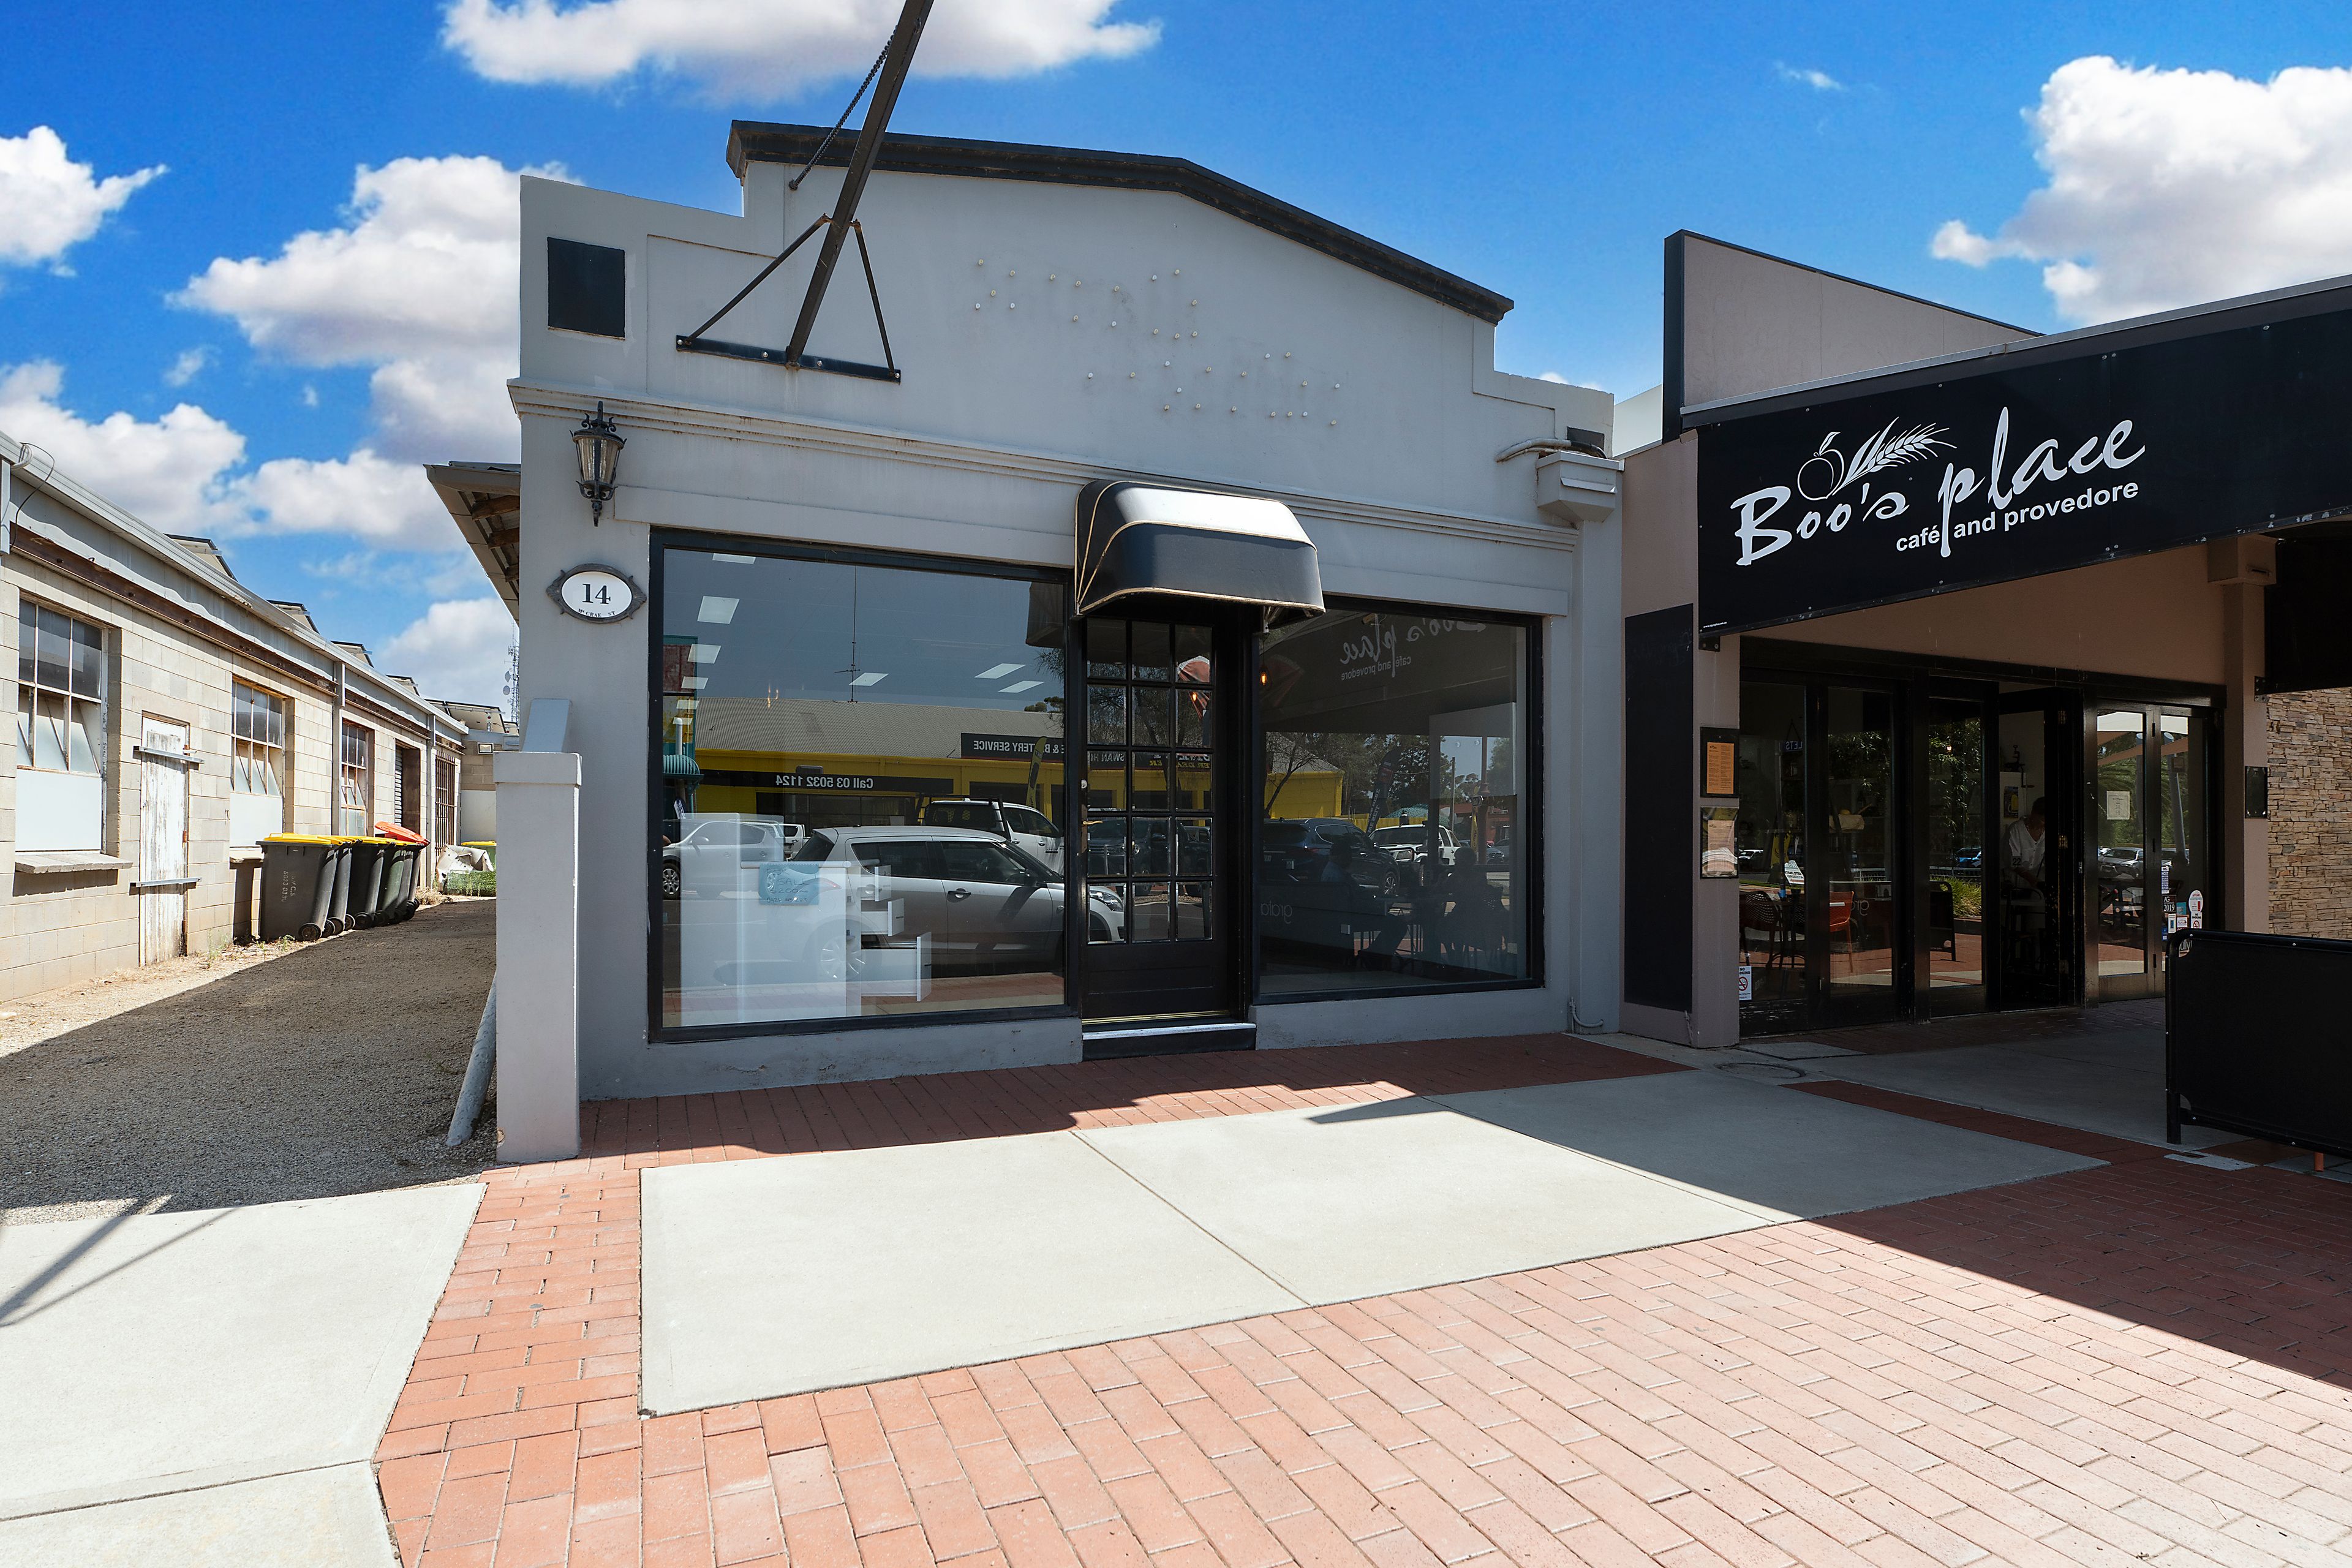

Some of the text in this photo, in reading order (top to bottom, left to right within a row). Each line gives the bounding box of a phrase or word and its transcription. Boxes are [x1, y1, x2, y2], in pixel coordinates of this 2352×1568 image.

[1730, 406, 2146, 567] Boo's place
[1895, 479, 2140, 552] café and provedore
[582, 583, 611, 605] 14
